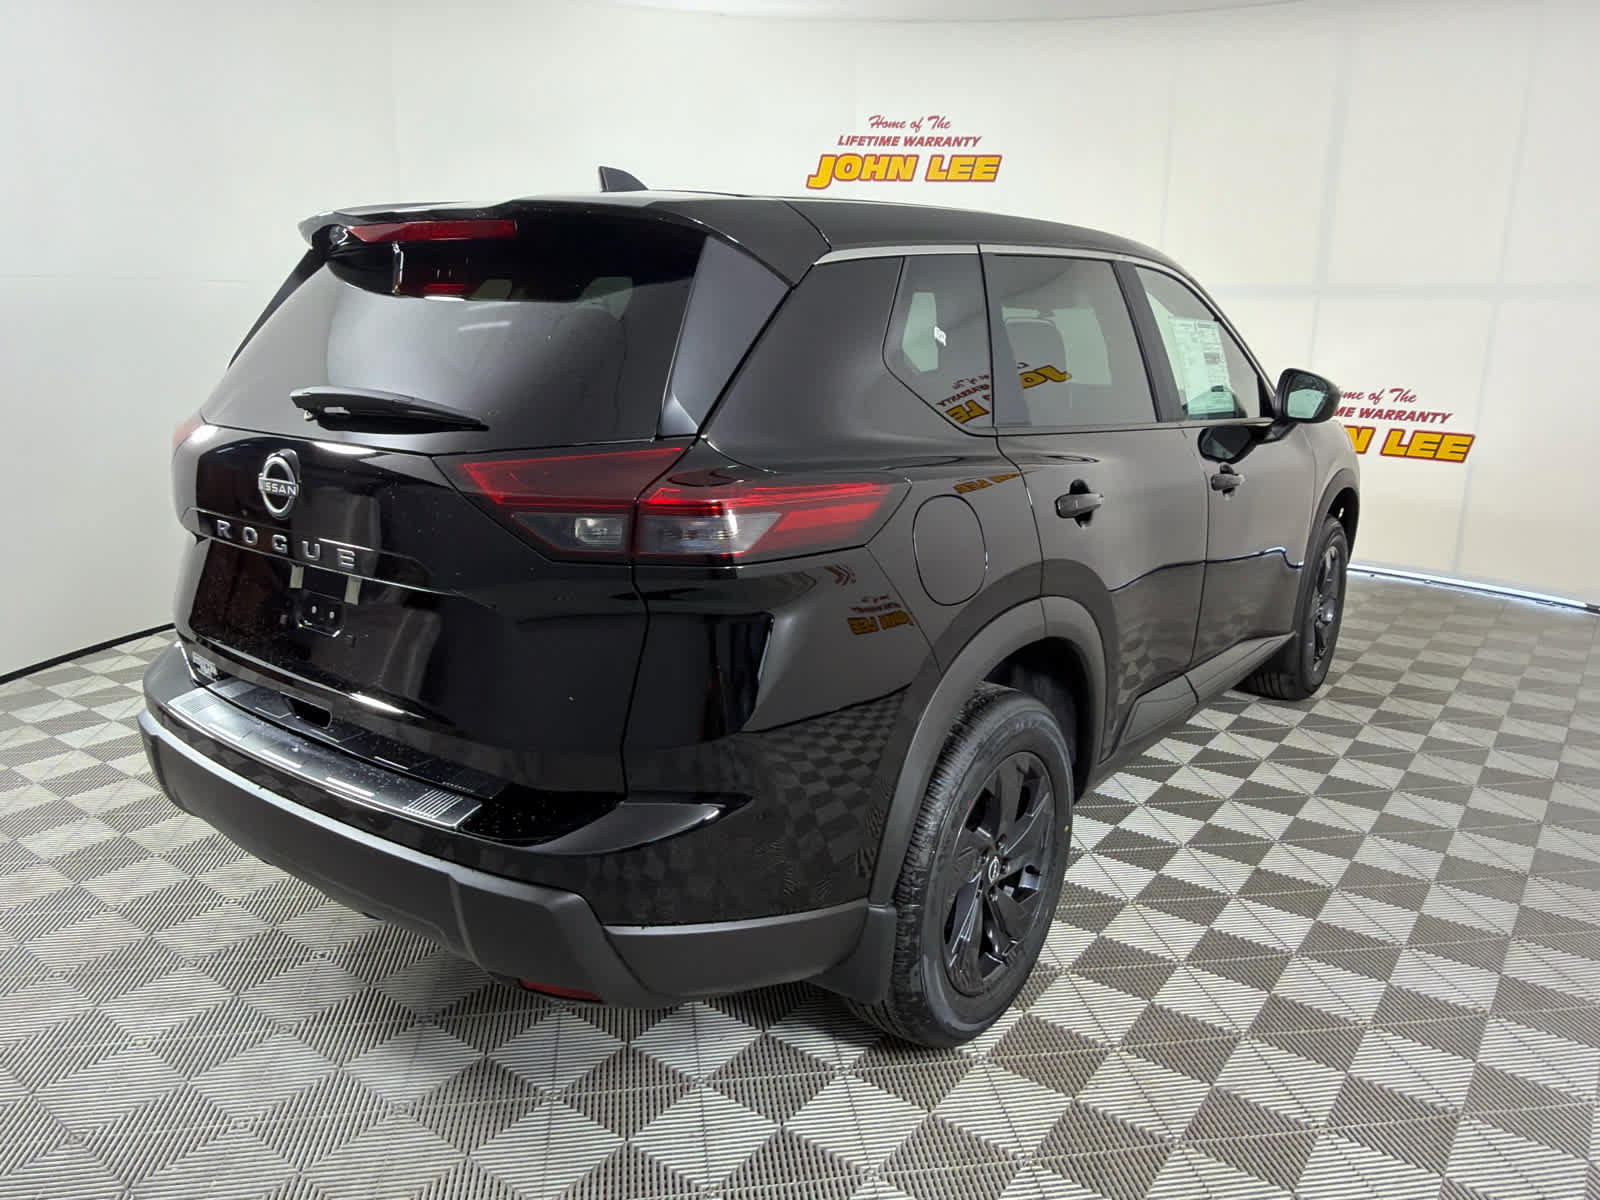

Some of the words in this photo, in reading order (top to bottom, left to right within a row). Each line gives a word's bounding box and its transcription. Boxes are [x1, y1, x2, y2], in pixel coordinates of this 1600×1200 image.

[868, 115, 906, 129] Home
[910, 116, 924, 133] of
[928, 115, 951, 129] The
[837, 135, 900, 147] LIFETIME
[903, 136, 982, 147] WARRANTY
[806, 153, 919, 190] JOHN
[925, 154, 1002, 182] LEE
[1368, 388, 1385, 405] of
[1390, 388, 1417, 403] The
[1359, 408, 1453, 424] WARRANTY
[1380, 428, 1476, 463] LEE
[217, 519, 356, 568] ROGUE
